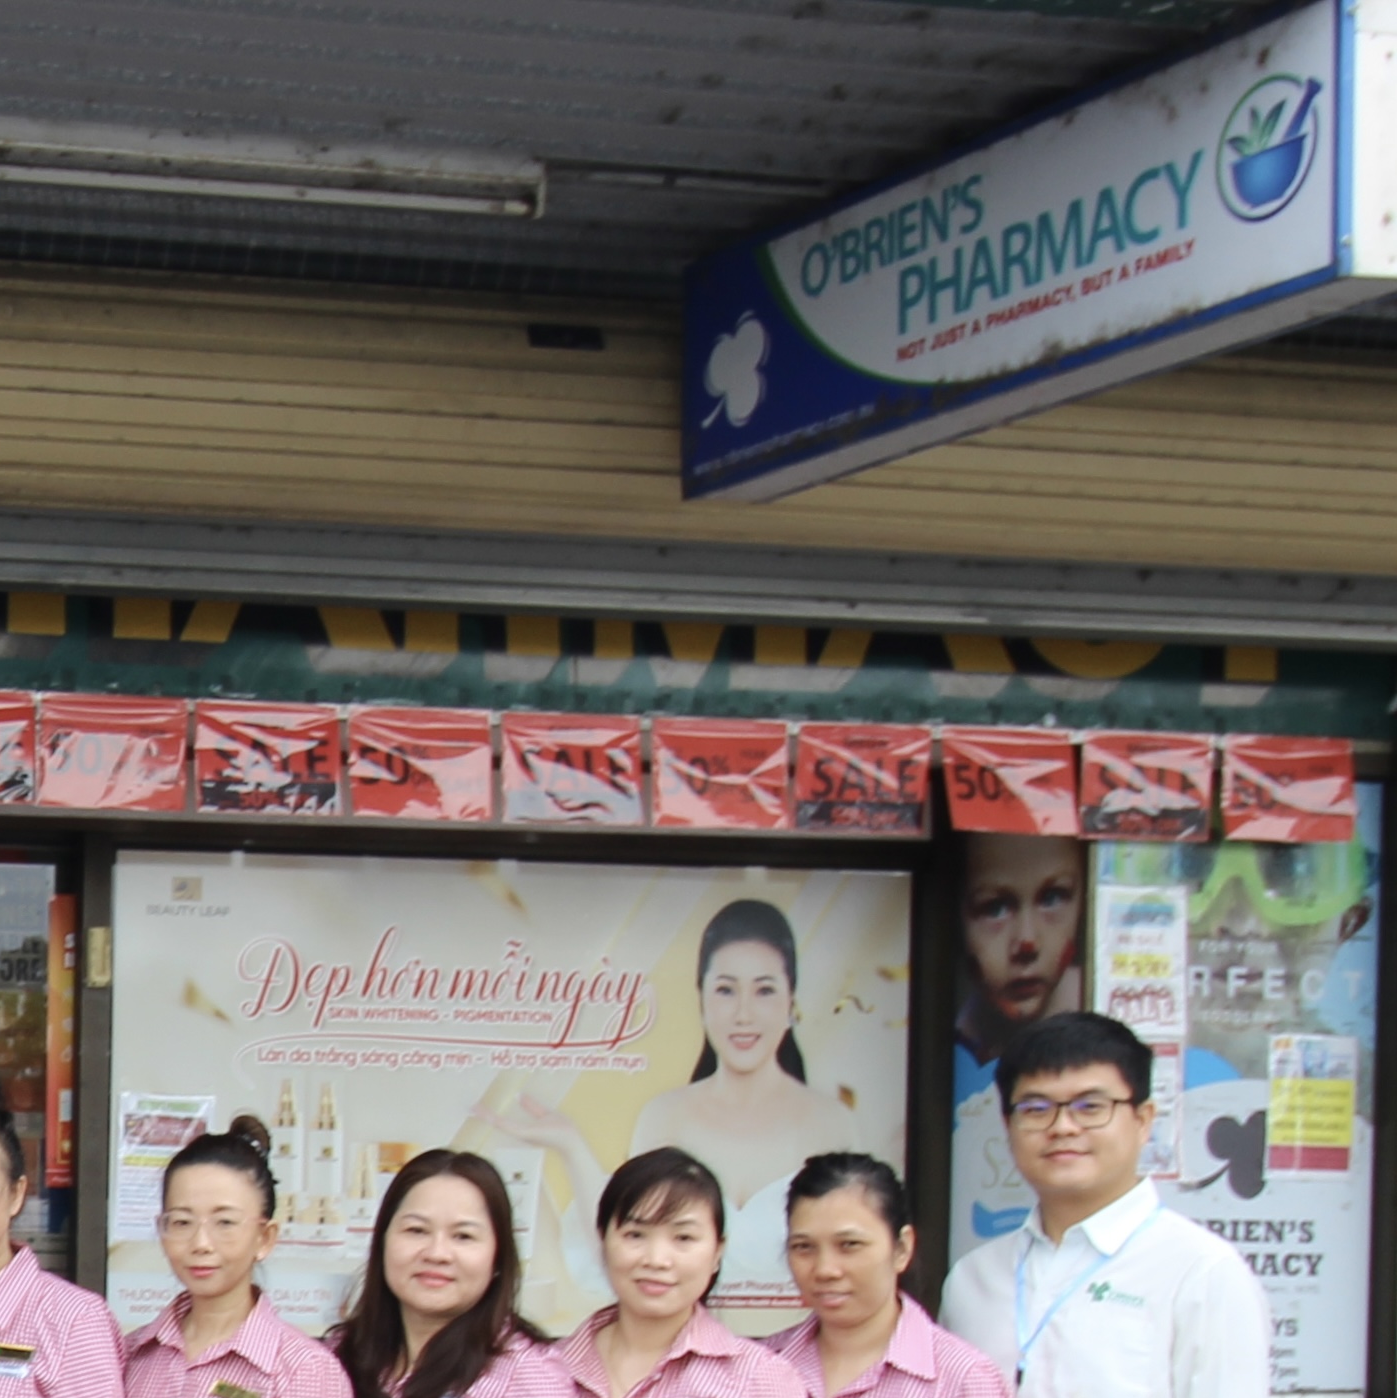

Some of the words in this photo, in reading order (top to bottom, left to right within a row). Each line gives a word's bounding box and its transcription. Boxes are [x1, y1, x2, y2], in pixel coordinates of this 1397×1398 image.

[801, 174, 984, 298] O'BRIEN'S
[897, 149, 1205, 335] PHARMACY
[896, 338, 926, 362] NOT
[930, 323, 967, 352] JUST
[971, 319, 983, 335] A
[1080, 270, 1115, 296] BUT
[1117, 264, 1132, 281] A
[1135, 239, 1196, 275] FAMILY
[810, 755, 920, 801] SALE
[1188, 964, 1364, 1001] RFECT
[327, 1006, 360, 1020] SKIN
[362, 1008, 439, 1022] WHITENING
[453, 1010, 554, 1025] PIGMENTATION
[1193, 1218, 1315, 1244] RIEN'S
